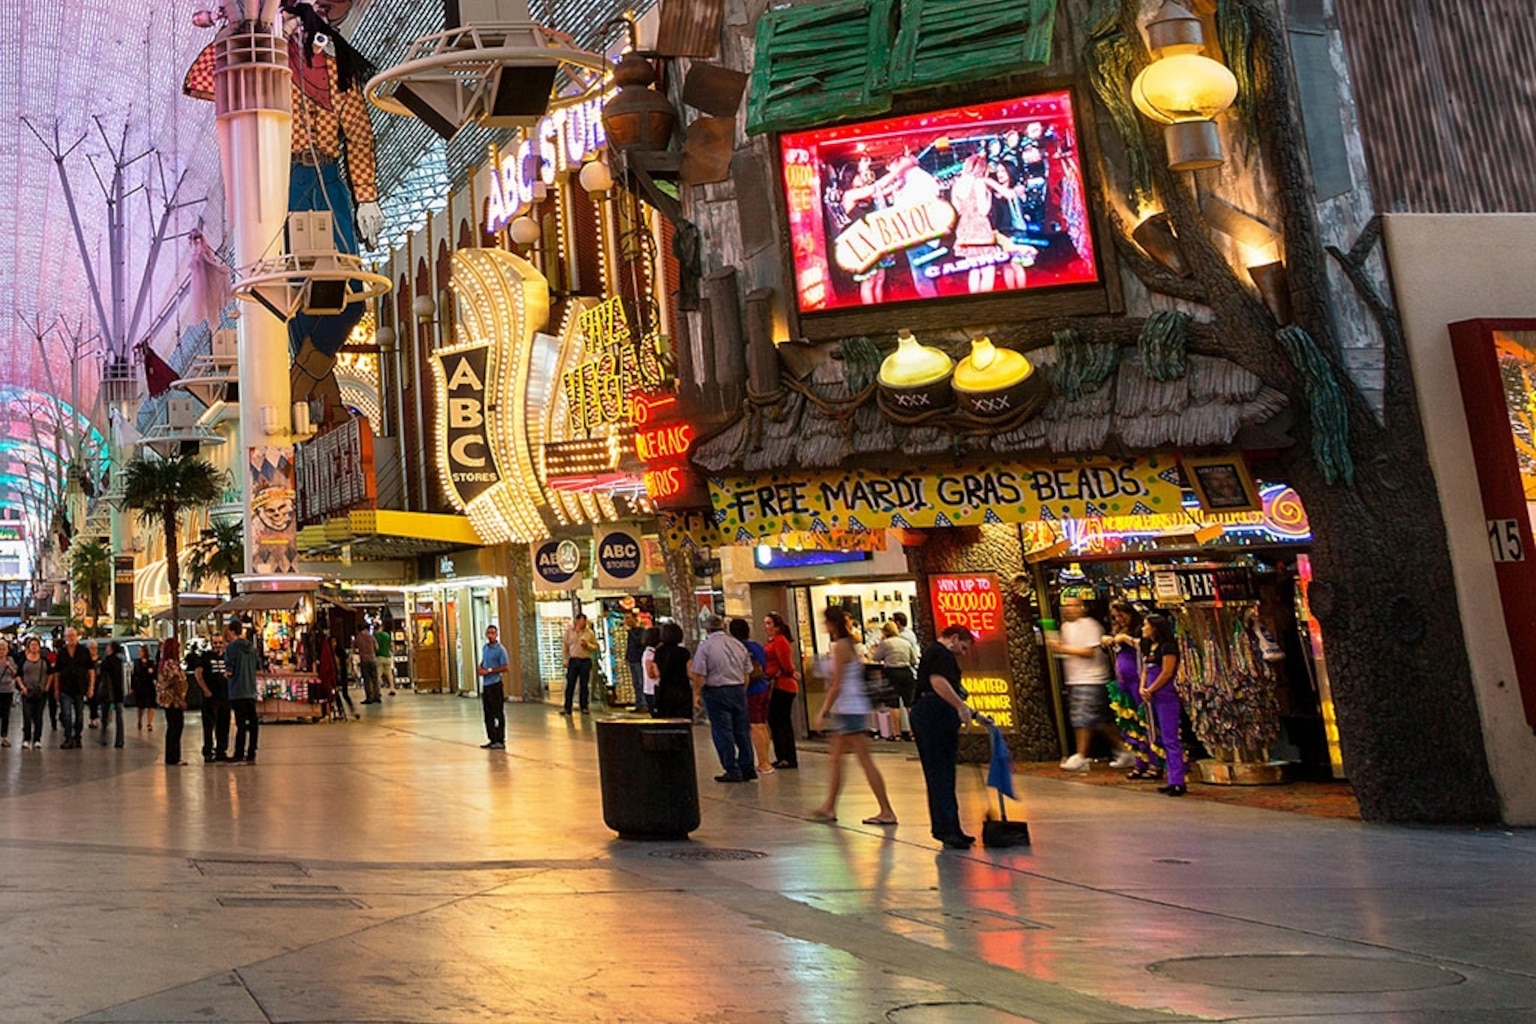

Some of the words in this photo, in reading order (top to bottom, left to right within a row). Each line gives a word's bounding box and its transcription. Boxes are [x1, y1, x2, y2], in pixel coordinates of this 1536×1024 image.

[486, 139, 533, 234] ABC
[448, 356, 486, 468] ABC
[452, 472, 498, 483] STORES
[734, 482, 809, 523] FREE
[821, 476, 929, 512] MARDI
[937, 473, 1022, 508] GRAS
[1488, 520, 1523, 562] 15
[539, 551, 558, 566] AB
[602, 543, 637, 559] ABC
[605, 559, 637, 570] STORES
[937, 579, 959, 592] WIN
[960, 578, 975, 592] UP
[975, 577, 991, 590] TO
[1176, 573, 1216, 596] REE
[944, 611, 995, 631] FREE
[961, 677, 1008, 694] RANTEED
